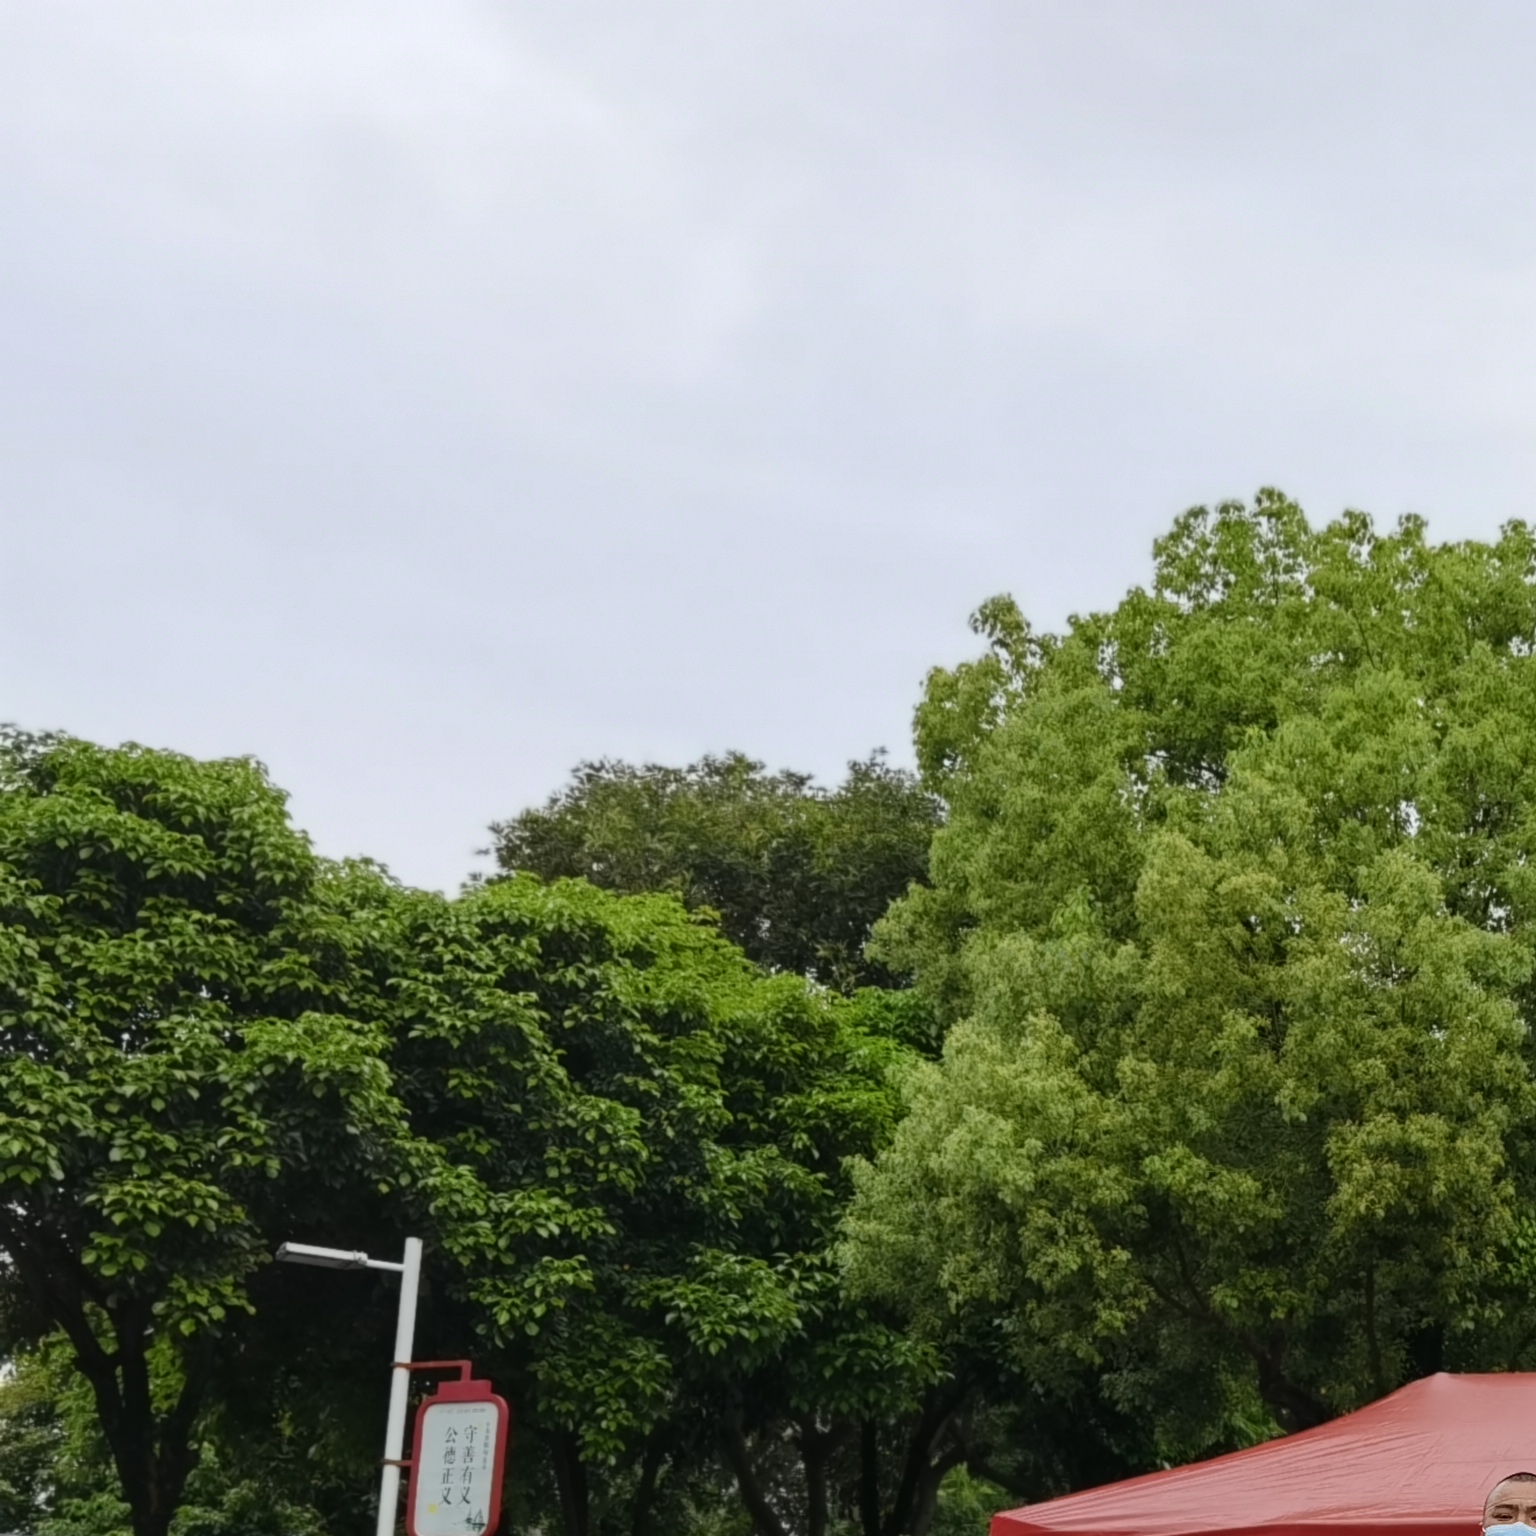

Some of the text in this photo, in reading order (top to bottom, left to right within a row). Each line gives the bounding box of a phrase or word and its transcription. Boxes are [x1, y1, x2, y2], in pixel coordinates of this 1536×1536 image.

[438, 1426, 458, 1506] 公德正义
[457, 1424, 479, 1506] 守善有义
